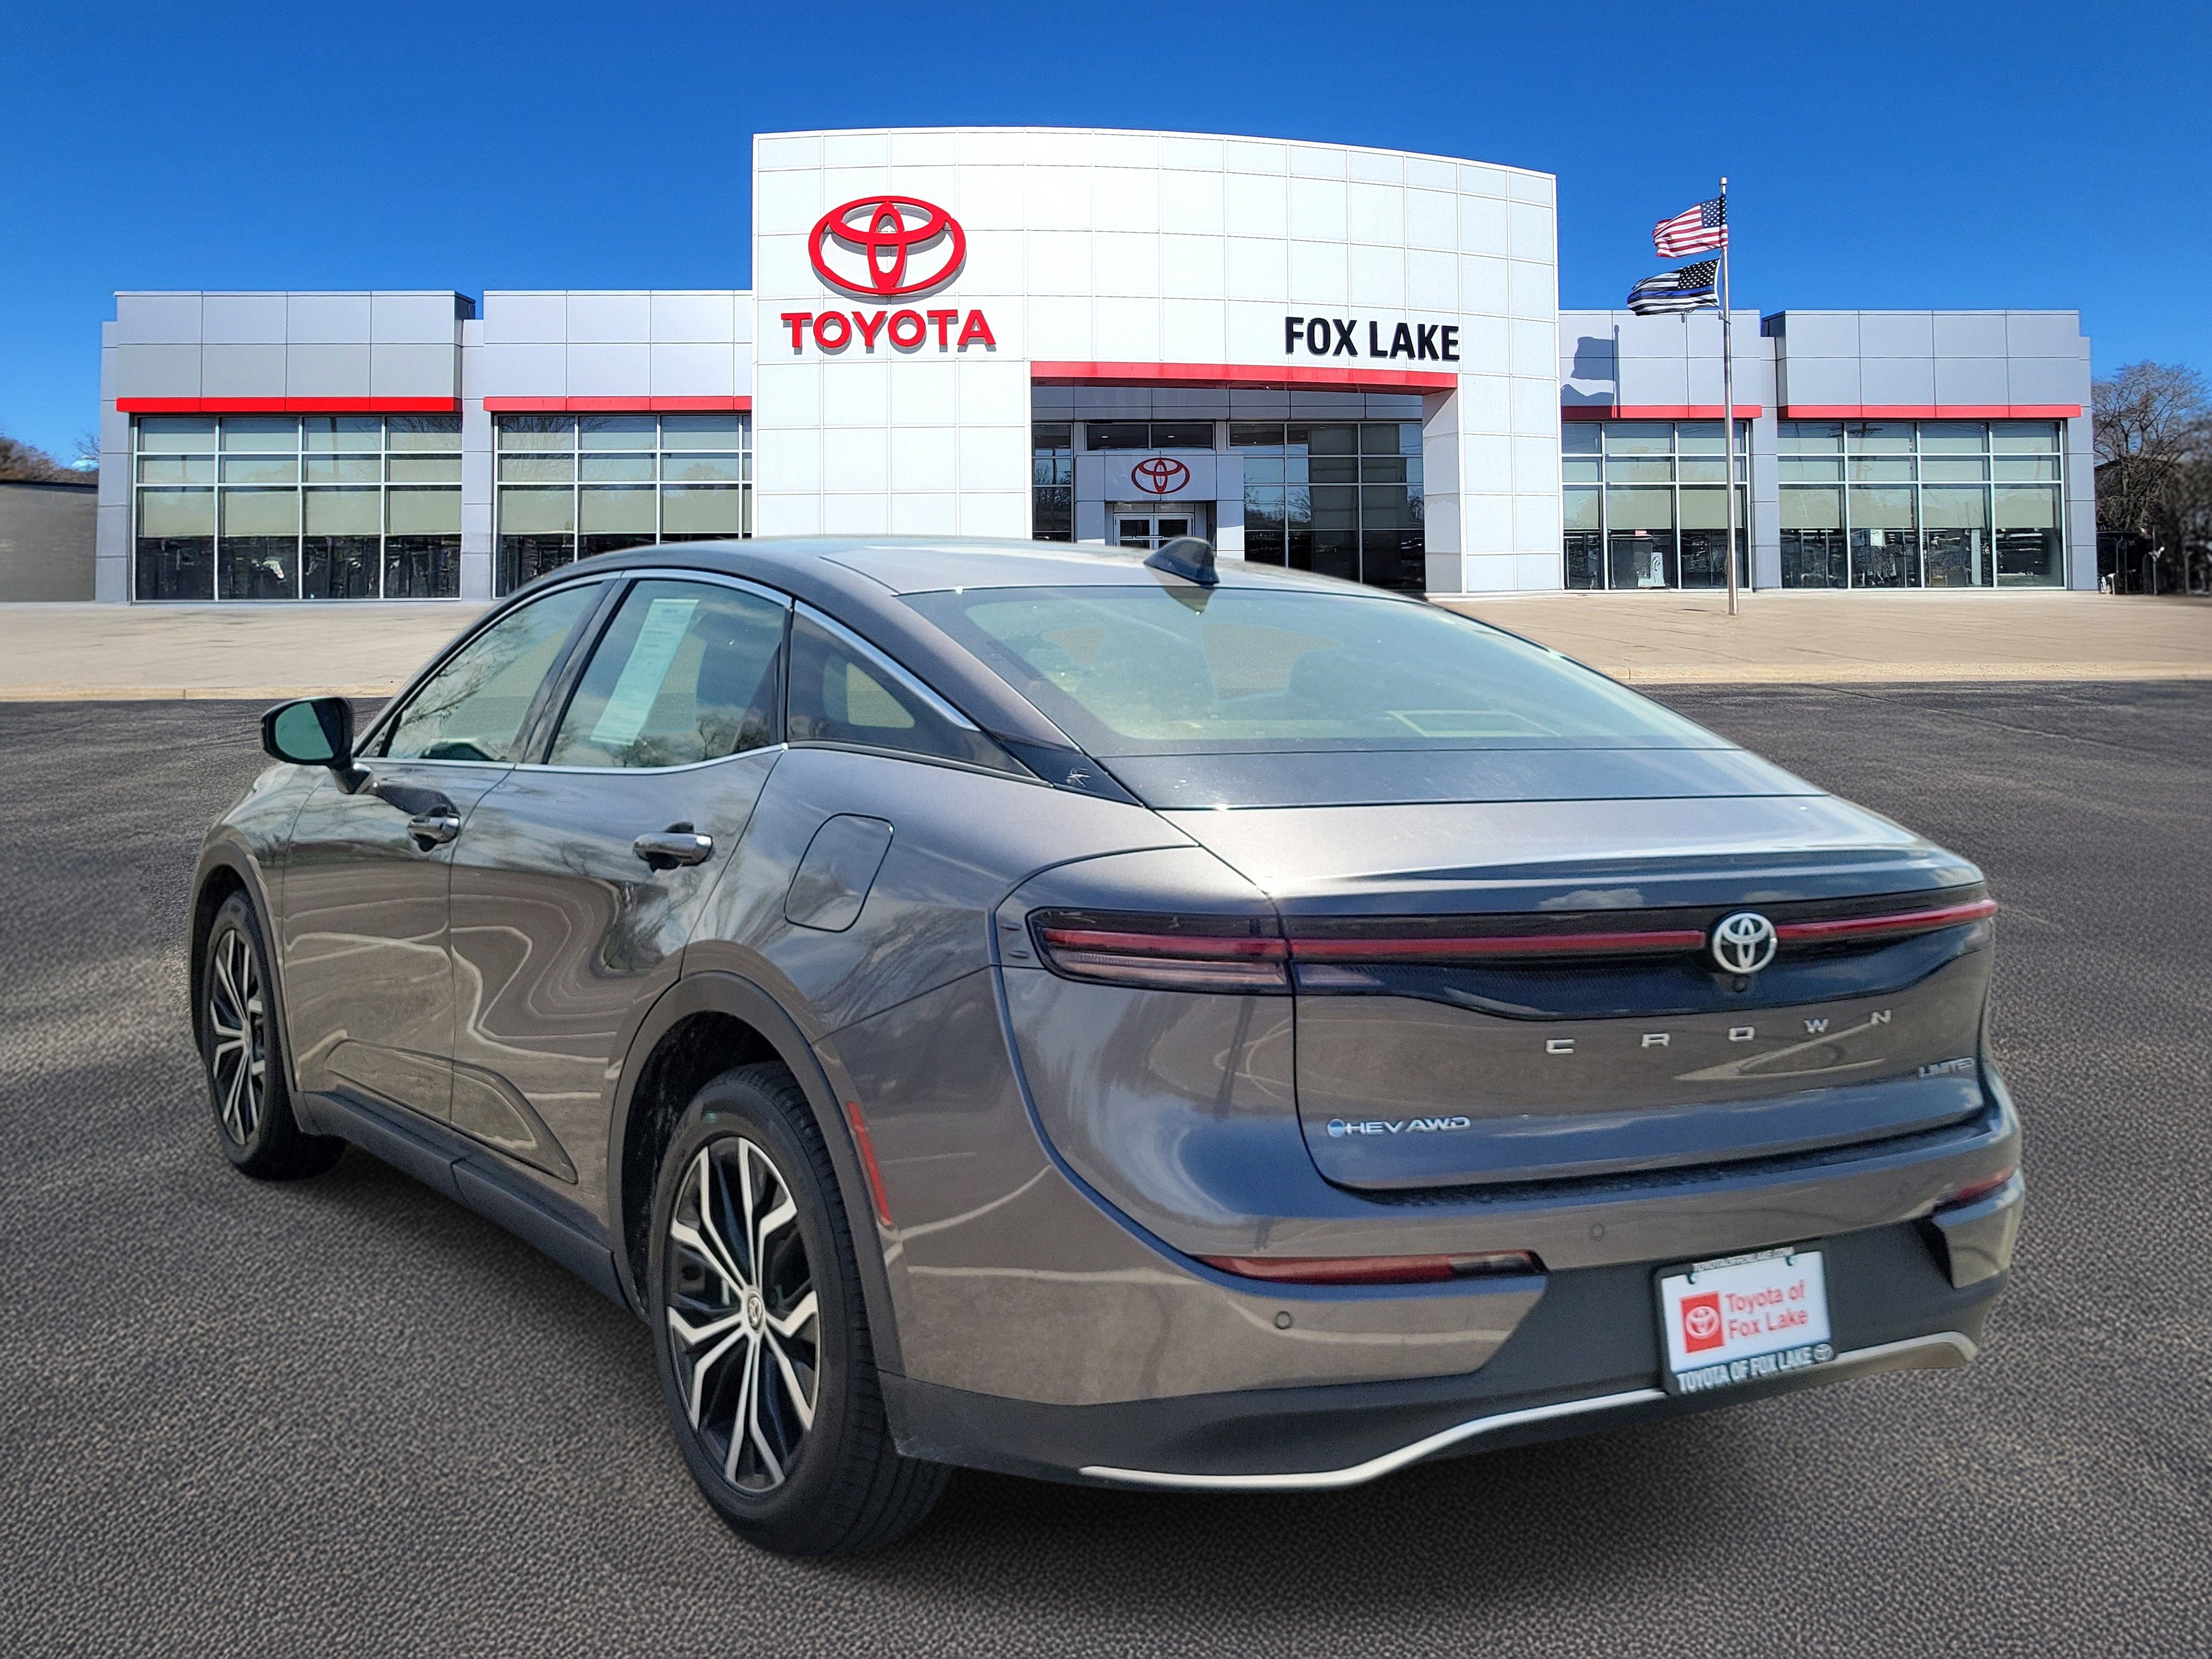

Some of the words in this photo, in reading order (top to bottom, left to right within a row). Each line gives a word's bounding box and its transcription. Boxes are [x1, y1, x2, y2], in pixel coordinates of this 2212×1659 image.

[781, 309, 996, 348] TOYOTA
[1285, 317, 1358, 356] FOX
[1369, 321, 1460, 360] LAKE
[1545, 1008, 1892, 1056] CROWN
[1404, 1116, 1472, 1133] AWD
[1725, 1288, 1784, 1314] Toyota
[1787, 1279, 1805, 1301] of
[1729, 1318, 1760, 1339] Fox
[1765, 1309, 1808, 1331] Lake
[1677, 1364, 1730, 1394] TOYOTA
[1730, 1359, 1749, 1383] OF
[1748, 1352, 1778, 1378] FOX
[1777, 1346, 1813, 1373] LAKE
